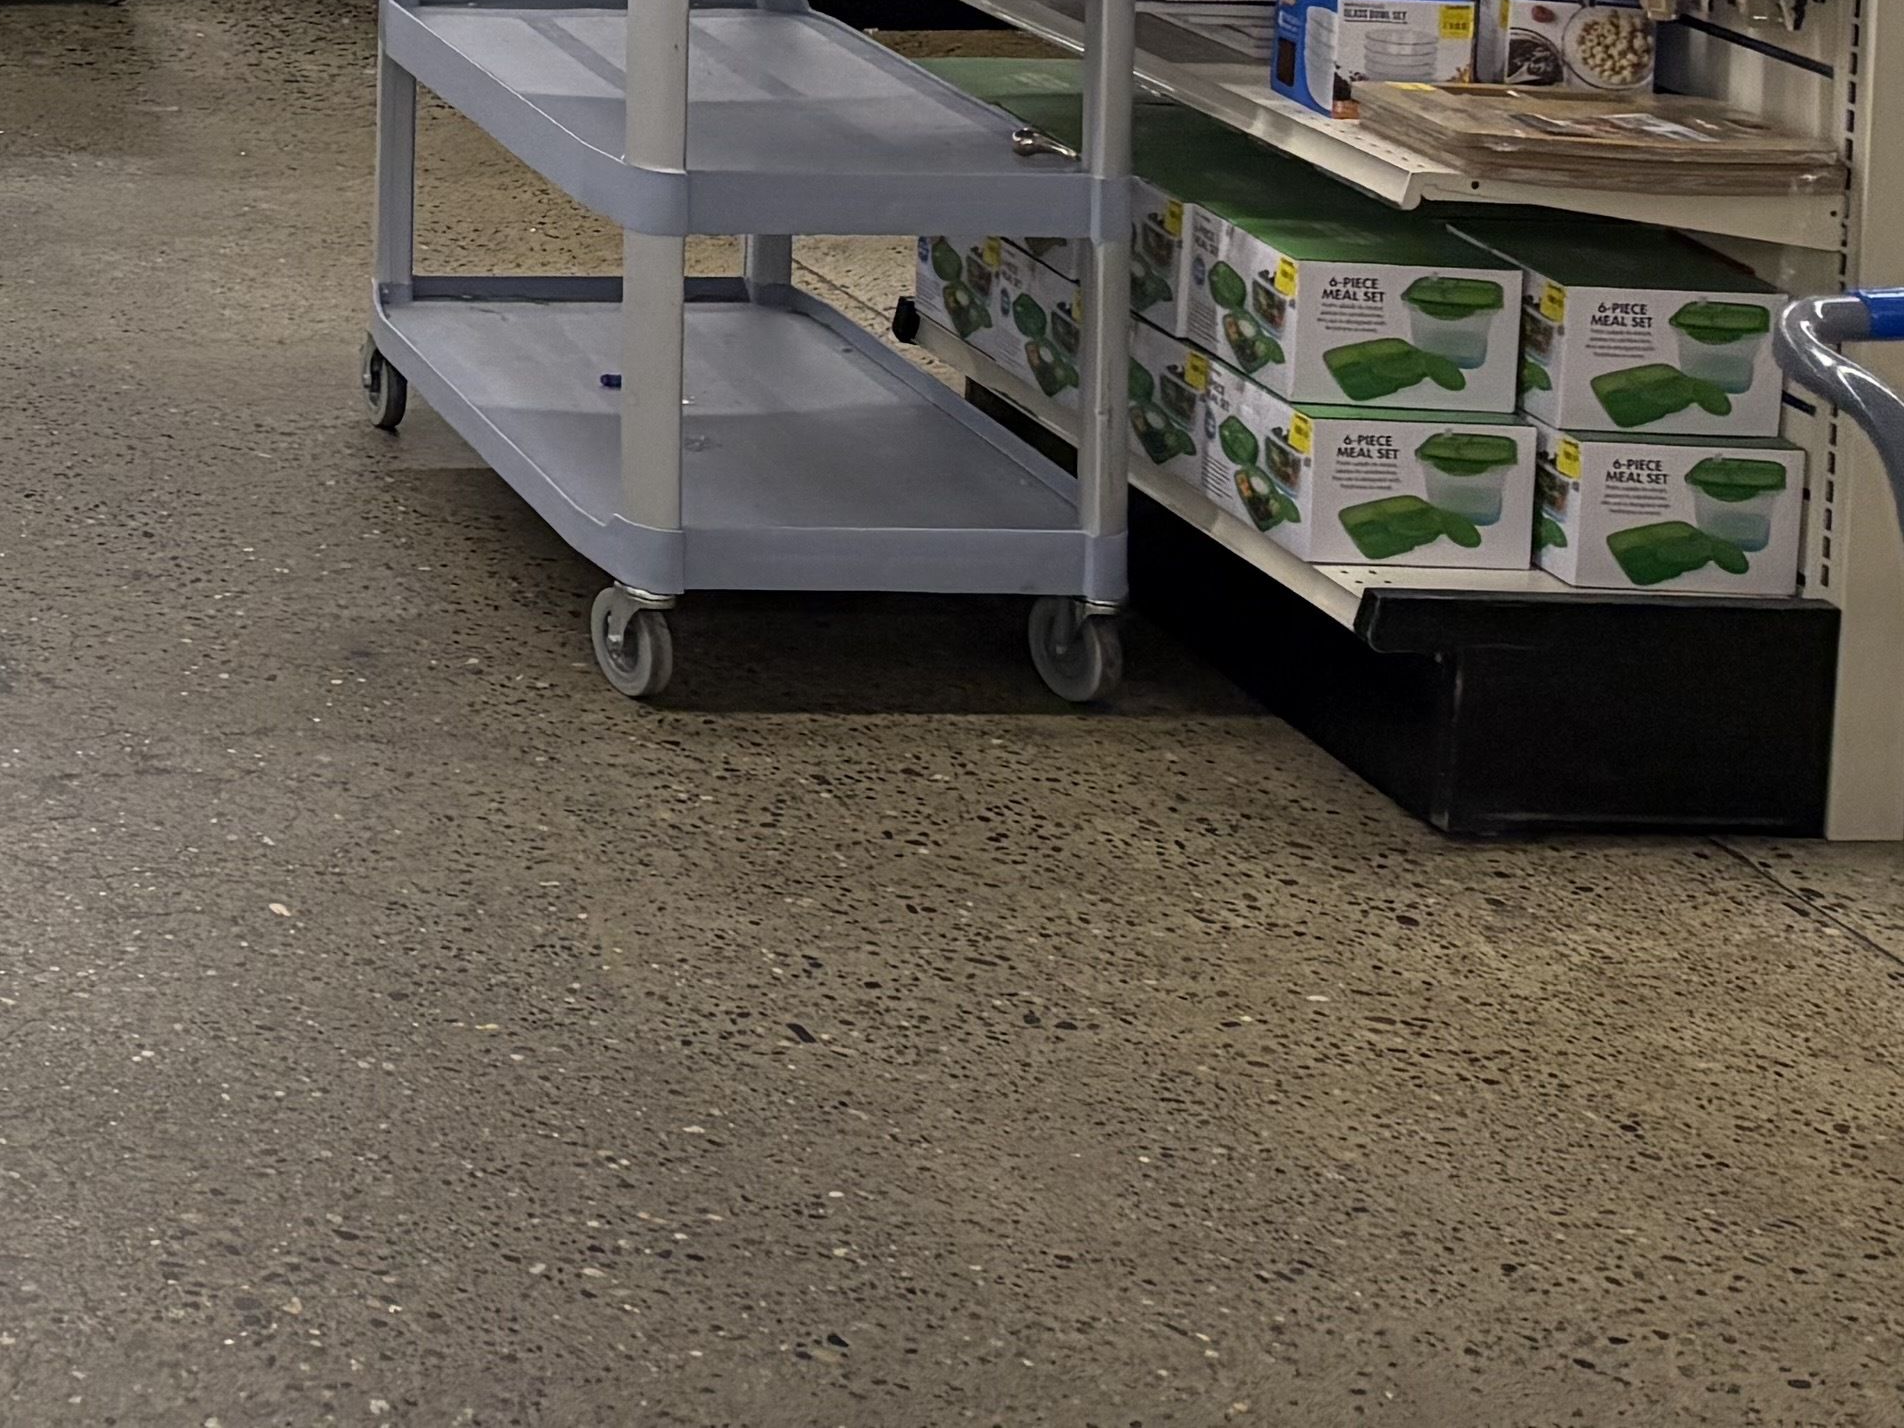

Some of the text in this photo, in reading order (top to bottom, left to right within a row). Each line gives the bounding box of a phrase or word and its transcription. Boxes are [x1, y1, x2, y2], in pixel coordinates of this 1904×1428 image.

[1392, 10, 1407, 21] SET
[1328, 276, 1380, 290] 6-PIECE
[1321, 288, 1386, 303] MEAL SET
[1597, 302, 1648, 315] 6-PIECE
[1590, 314, 1654, 329] MEAL SET
[1343, 434, 1392, 447] 6-PIECE
[1336, 446, 1400, 460] MEAL SET
[1612, 458, 1663, 471] 6-PIECE
[1605, 470, 1671, 485] MEAL SET
